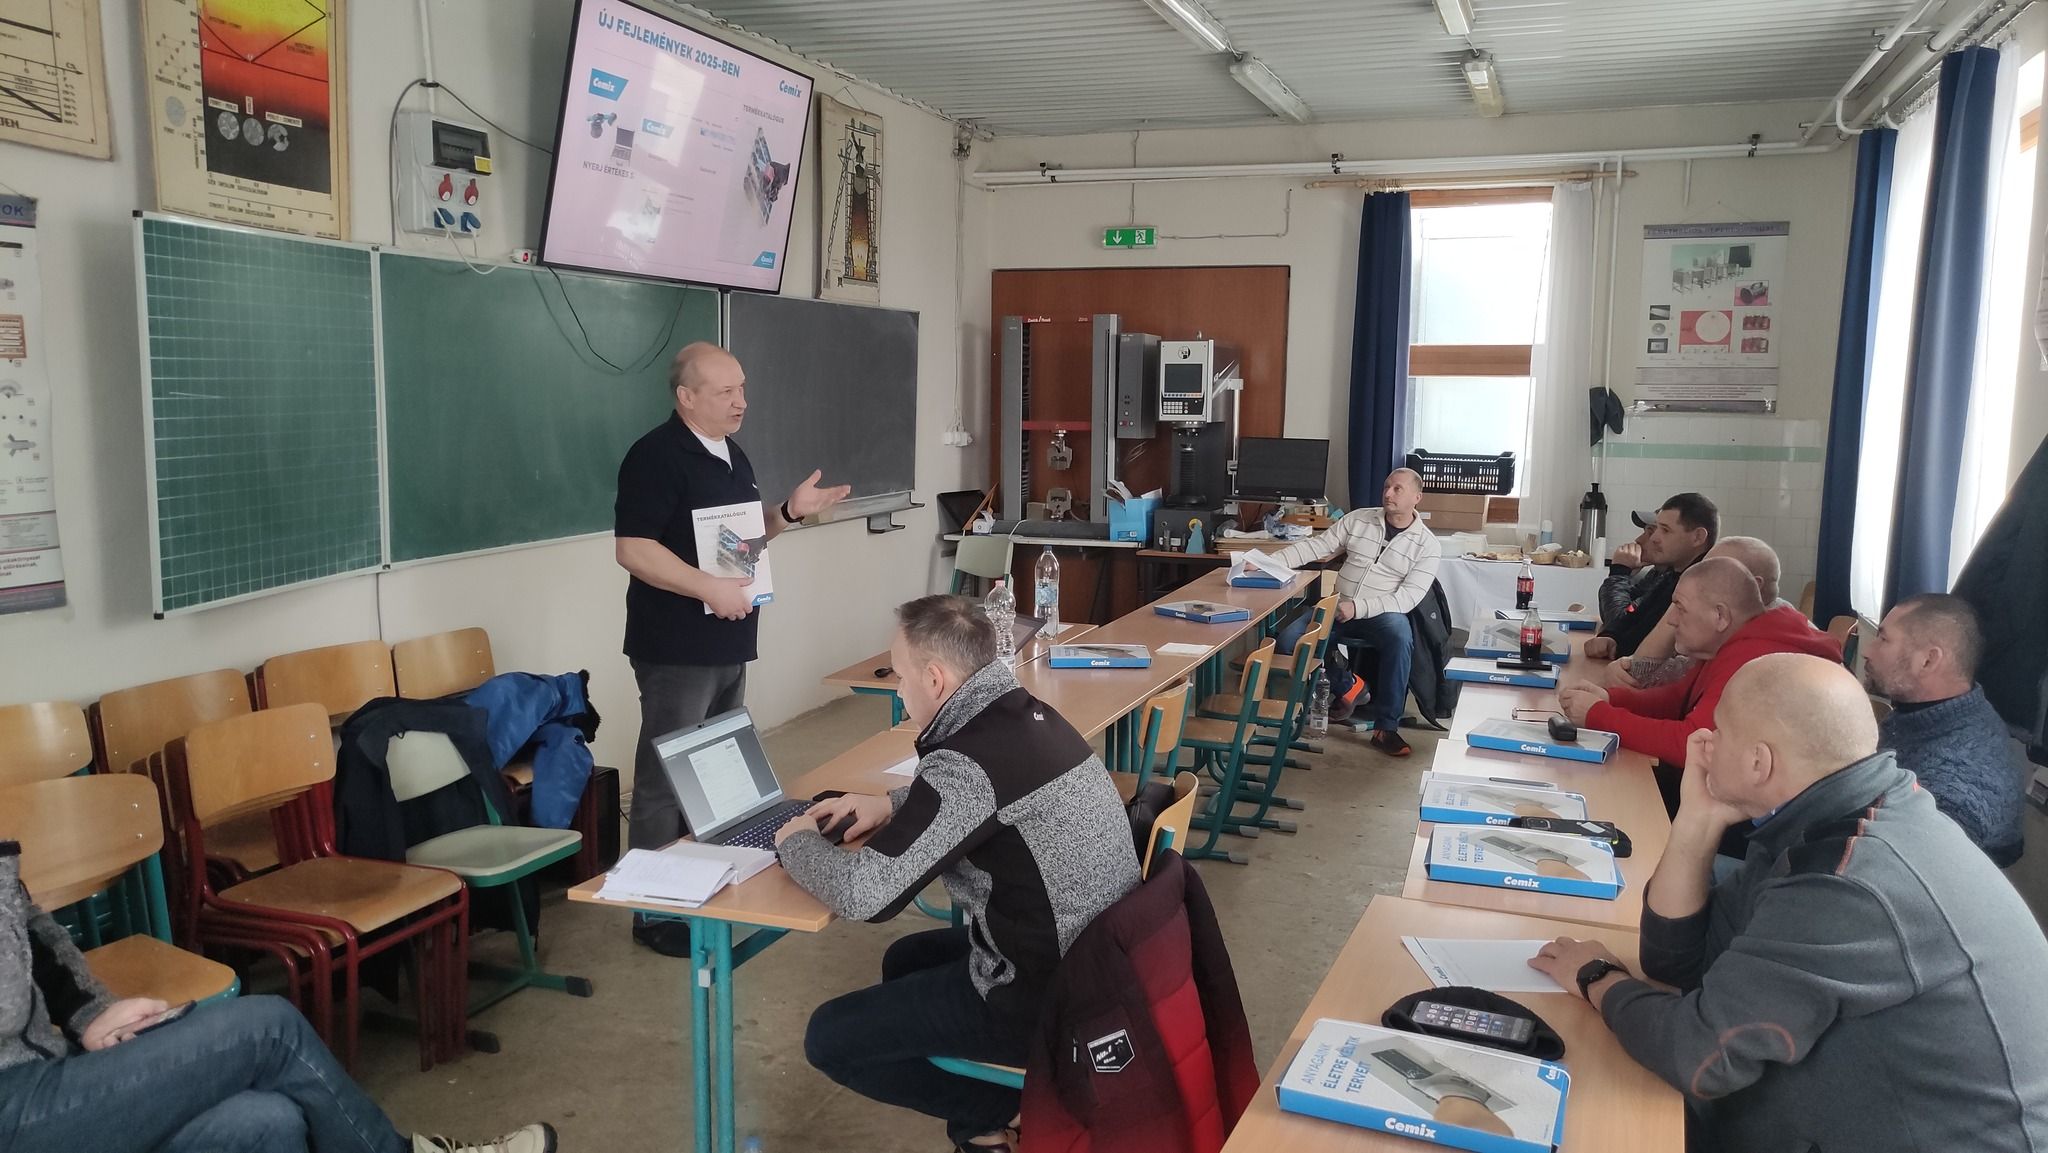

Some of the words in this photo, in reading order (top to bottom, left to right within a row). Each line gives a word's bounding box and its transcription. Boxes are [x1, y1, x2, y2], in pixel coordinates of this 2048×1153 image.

[599, 8, 614, 29] ÚJ
[616, 18, 693, 60] FEJLEMÉNYEK
[695, 50, 740, 78] 2025-BEN
[593, 77, 616, 92] Cemix
[779, 80, 802, 98] Cemix
[1521, 744, 1547, 753] Cemix
[1486, 816, 1511, 826] Cemi
[1504, 876, 1540, 888] Cemix
[1320, 1058, 1349, 1089] ÉLETRE
[1346, 1060, 1371, 1093] TERVEIT
[1385, 1117, 1436, 1139] Cemix
